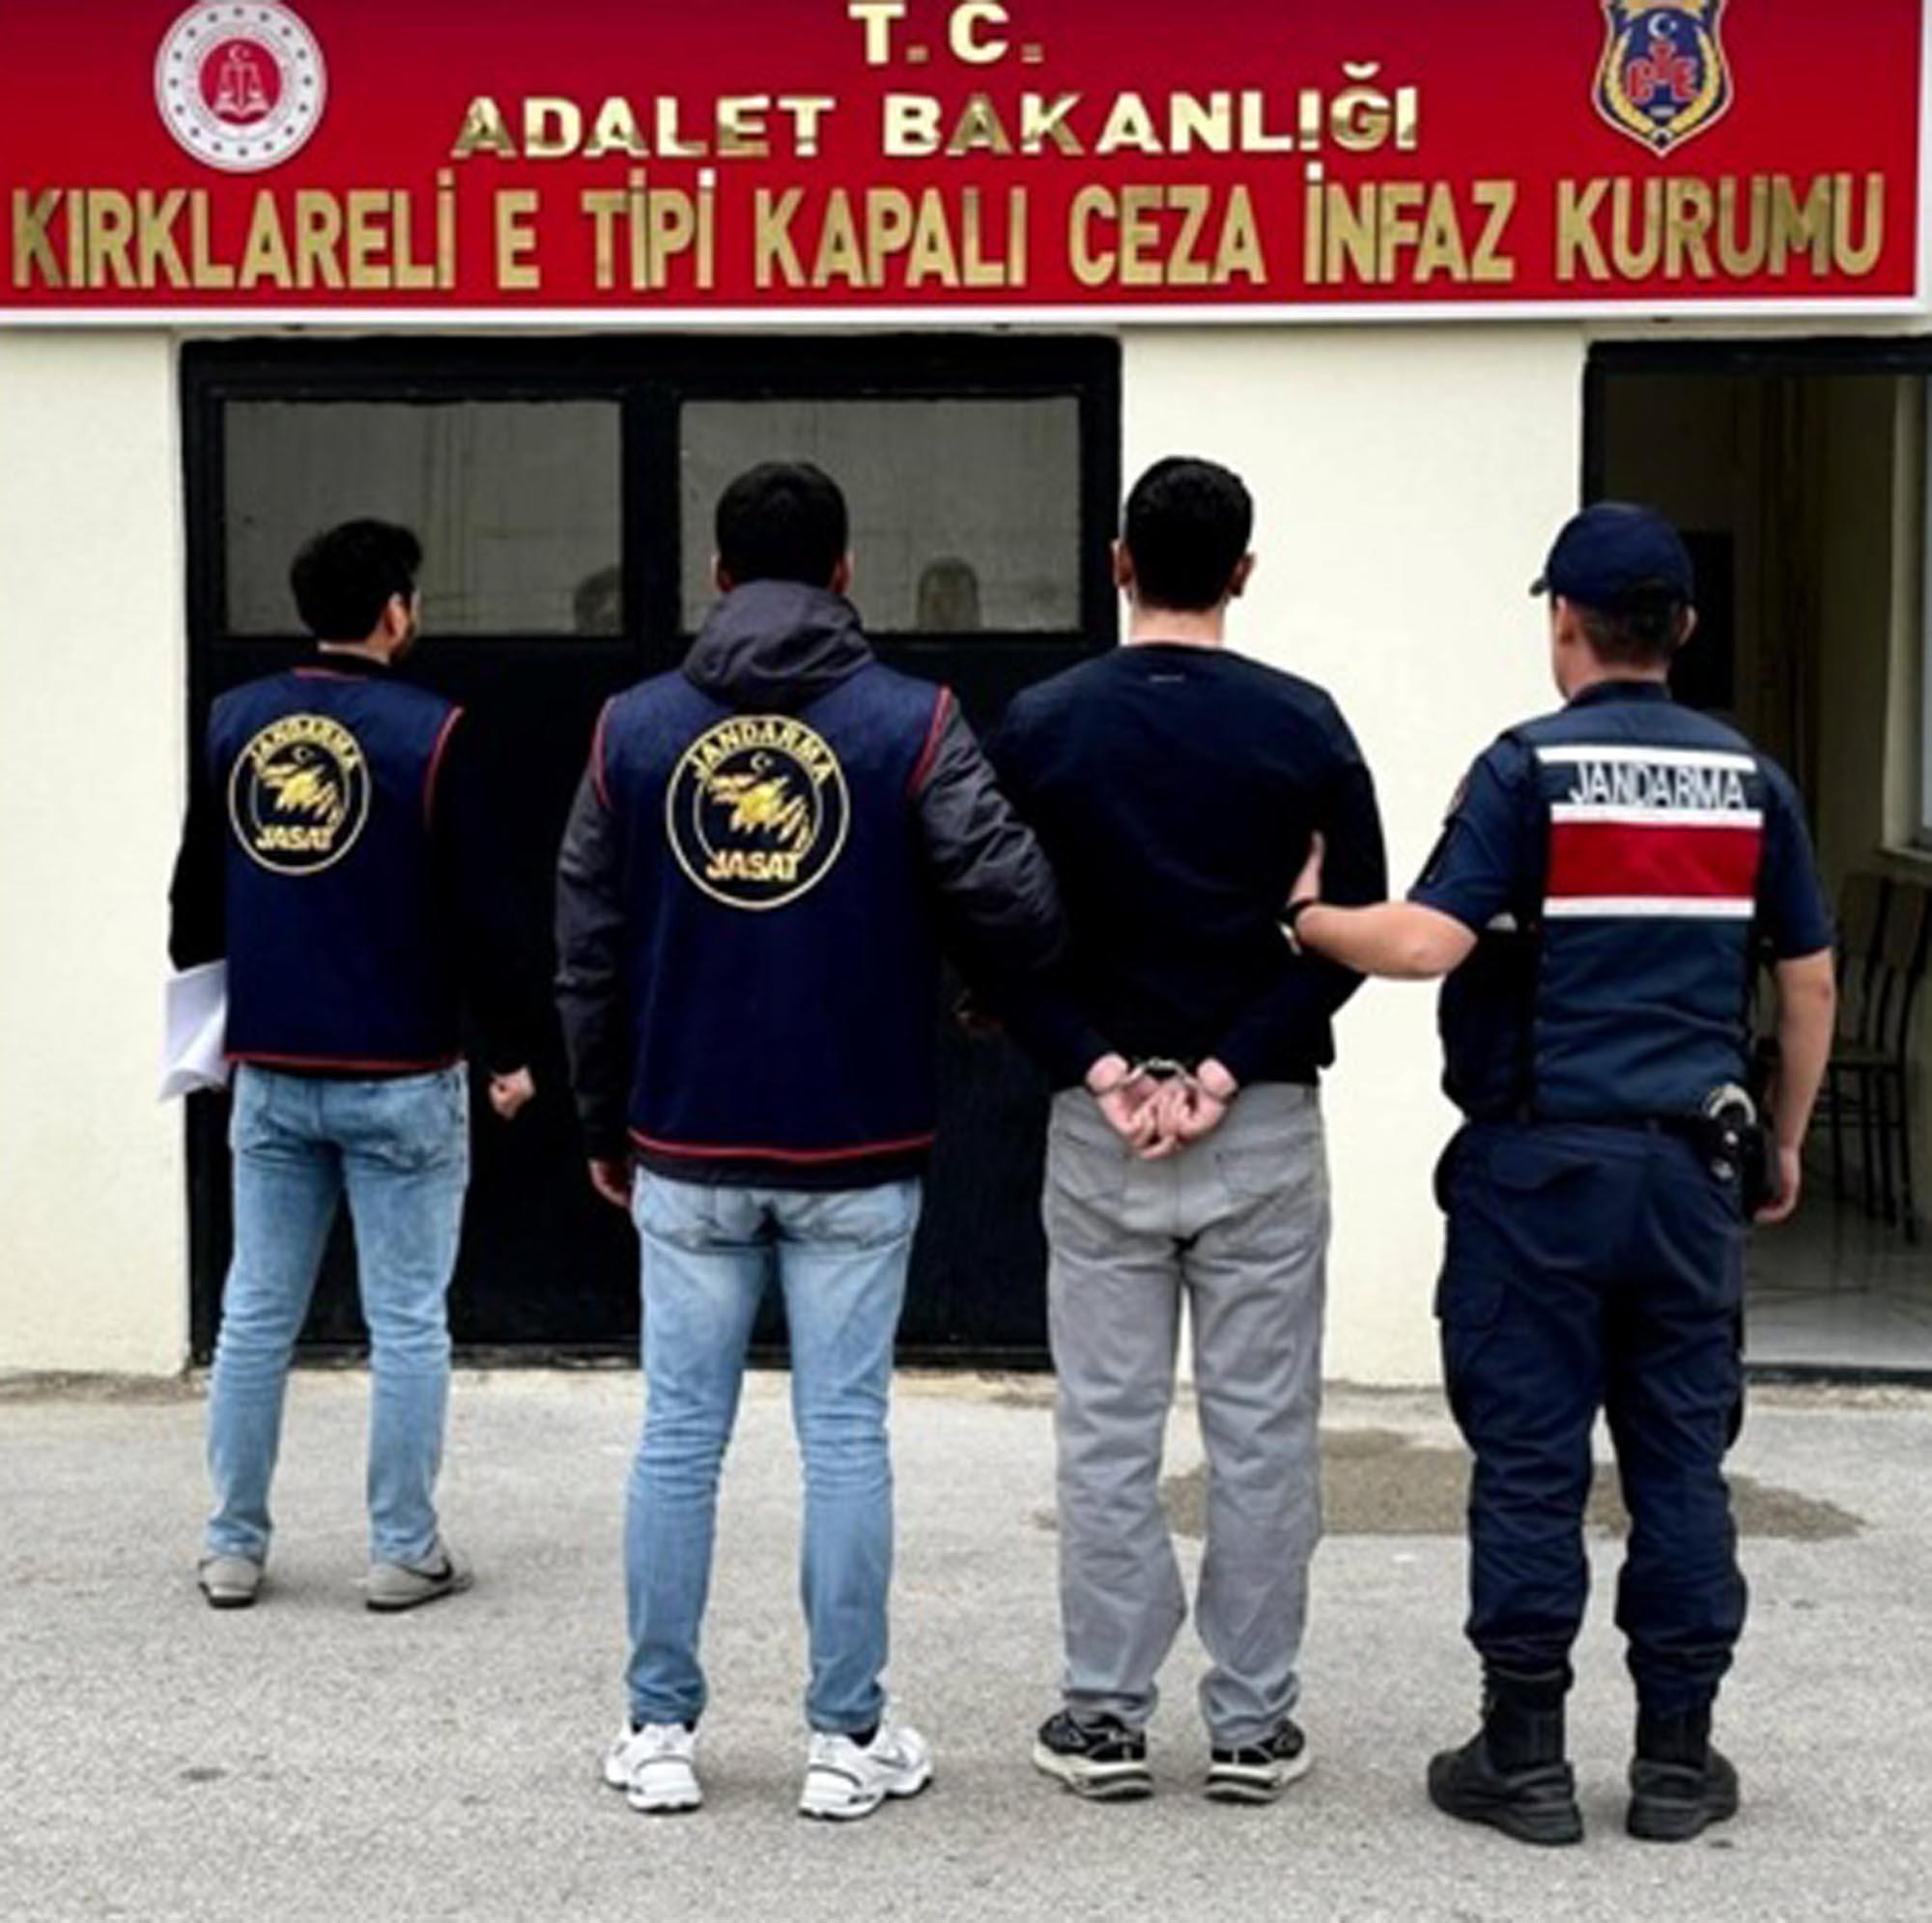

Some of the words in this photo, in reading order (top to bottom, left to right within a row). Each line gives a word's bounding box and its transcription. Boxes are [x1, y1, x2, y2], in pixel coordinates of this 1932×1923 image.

[451, 94, 837, 159] ADALET
[883, 62, 1418, 158] BAKANLIĞI
[11, 169, 457, 291] KIRKLARELİ
[497, 189, 540, 291] E
[582, 168, 715, 291] TİPİ
[753, 184, 1027, 290] KAPALI
[1067, 184, 1267, 288] CEZA
[1304, 161, 1516, 287] İNFAZ
[1554, 172, 1887, 283] KURUMU
[690, 719, 836, 784] JANDARMA
[1568, 758, 1747, 811] JANDARMA
[704, 849, 800, 882] JASAT
